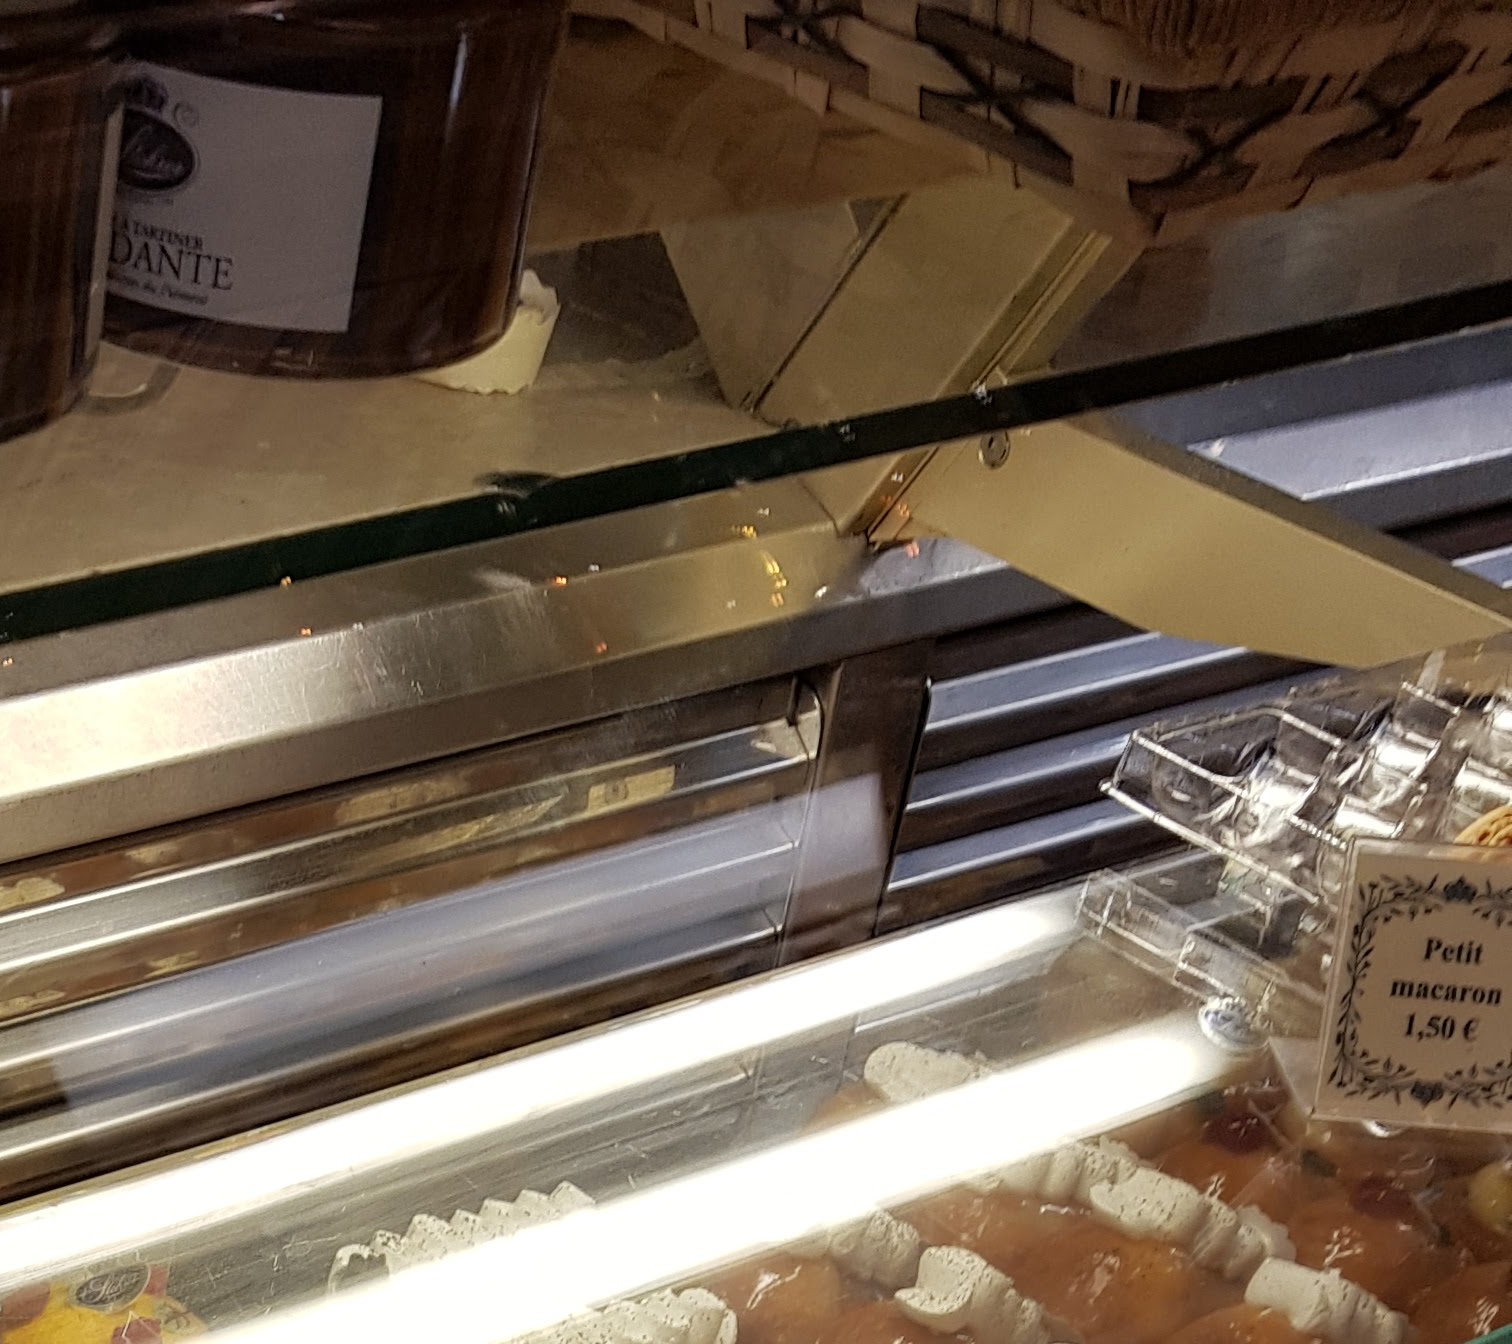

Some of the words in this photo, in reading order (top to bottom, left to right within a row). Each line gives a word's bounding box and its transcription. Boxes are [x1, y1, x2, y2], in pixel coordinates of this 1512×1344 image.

[109, 232, 234, 291] DANTE
[1424, 937, 1484, 965] Petit
[1389, 980, 1503, 1006] macaron
[1405, 1012, 1456, 1042] 1,50
[1462, 1016, 1481, 1042] €
